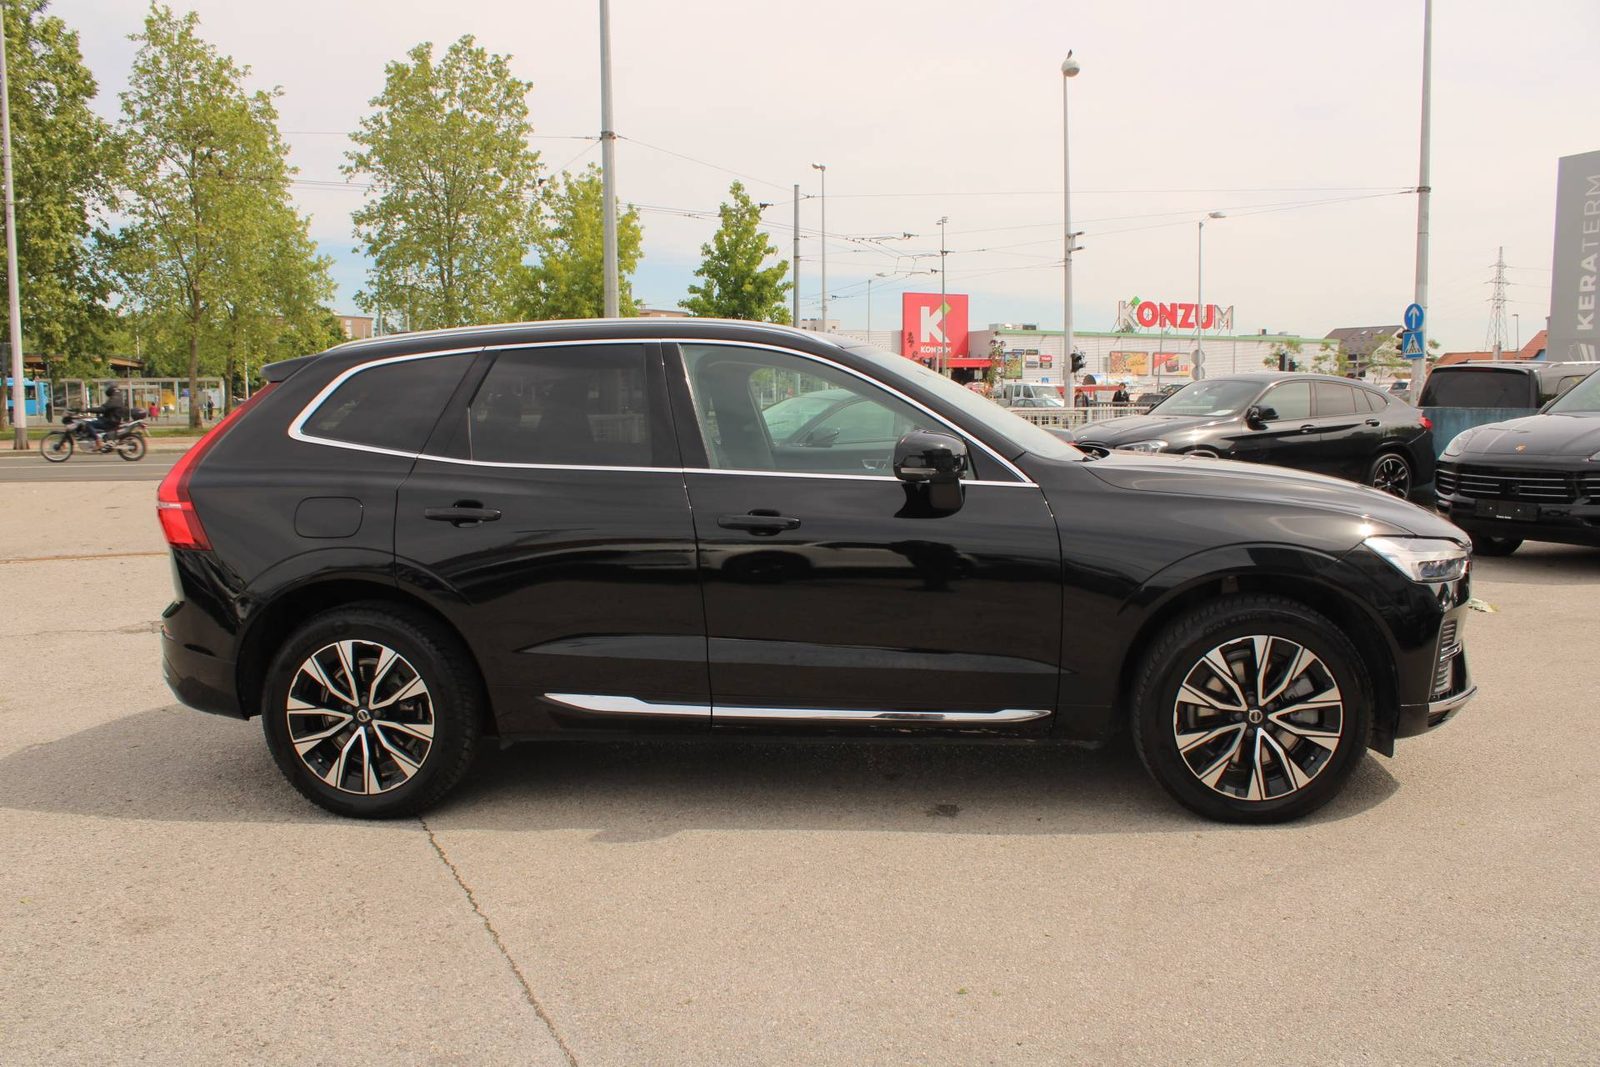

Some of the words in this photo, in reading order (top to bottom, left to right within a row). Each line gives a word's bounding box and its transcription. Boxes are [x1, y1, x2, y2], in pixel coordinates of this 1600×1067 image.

[1576, 175, 1600, 329] KERATERM
[920, 303, 951, 343] K
[1118, 297, 1234, 330] KONZUM
